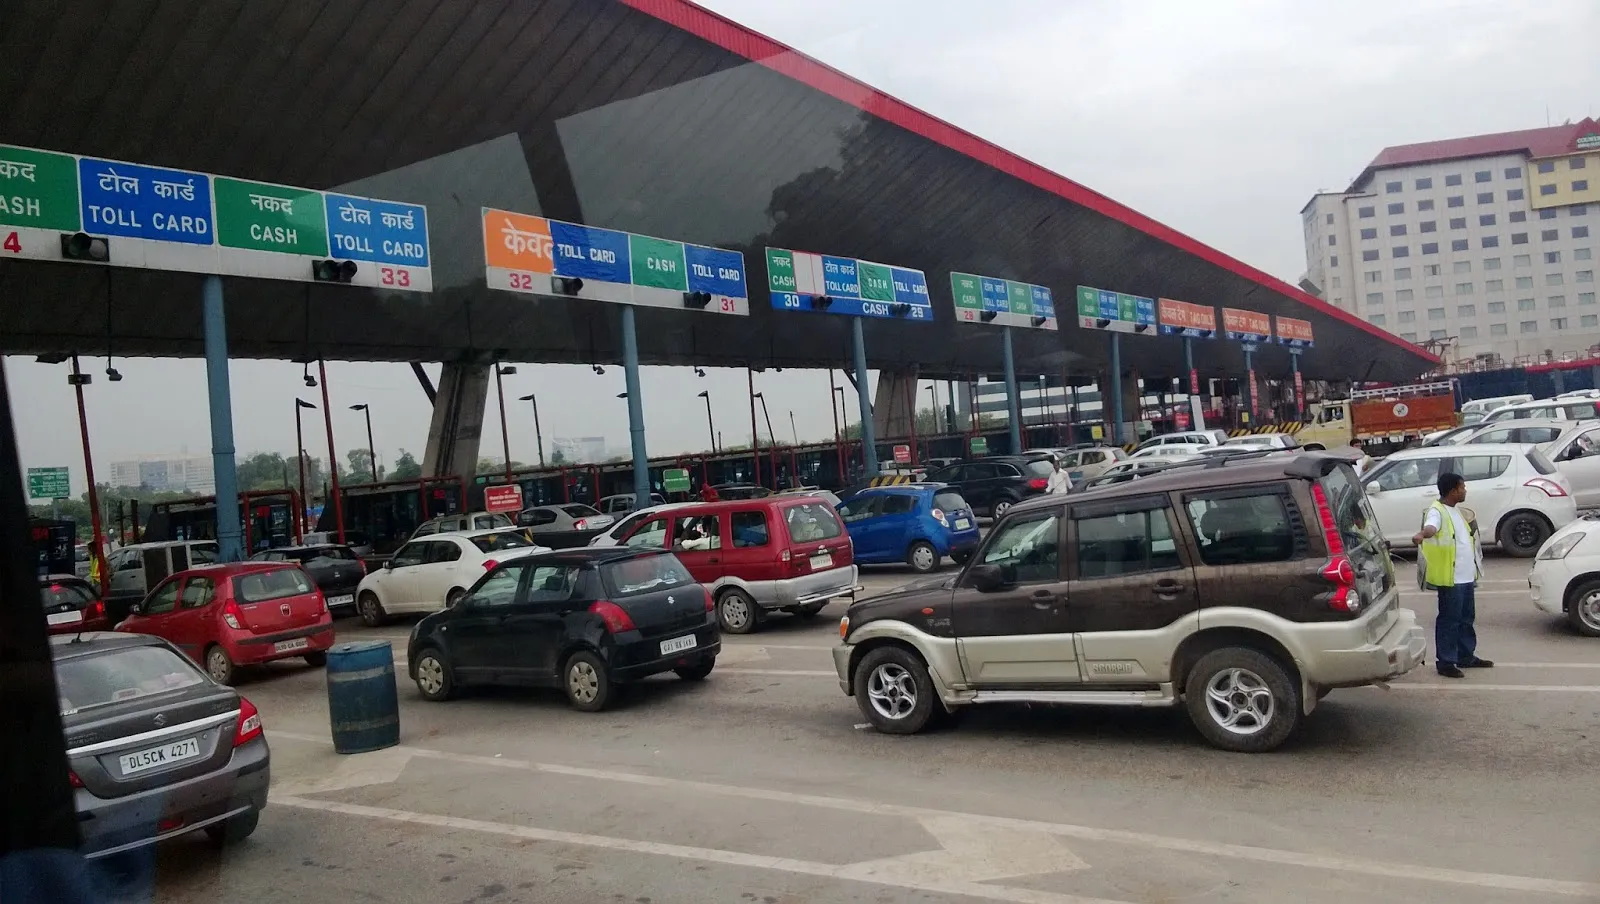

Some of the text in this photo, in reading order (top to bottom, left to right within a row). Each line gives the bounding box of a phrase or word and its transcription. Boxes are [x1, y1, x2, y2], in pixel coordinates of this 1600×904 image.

[97, 168, 194, 201] टोल कार्ड
[249, 194, 293, 215] नकद
[88, 205, 207, 235] TOLL CARD
[339, 202, 414, 230] टोल कार्ड
[250, 224, 298, 245] CASH
[334, 234, 424, 259] TOLL CARD
[558, 242, 616, 265] TOLL CARD
[647, 257, 676, 273] CASH
[772, 256, 791, 268] नकद
[825, 260, 838, 274] टोल
[381, 267, 410, 287] 33
[509, 272, 533, 290] 32
[692, 263, 740, 282] TOLL CARD
[772, 275, 795, 287] CASH
[826, 280, 858, 294] TOLL CARD
[868, 277, 887, 289] CASH
[895, 280, 927, 294] TOLL CARD
[721, 298, 735, 312] 31
[784, 294, 799, 307] 30
[862, 303, 889, 315] CASH
[912, 306, 923, 318] 29
[129, 742, 196, 768] DL5CK 4271
